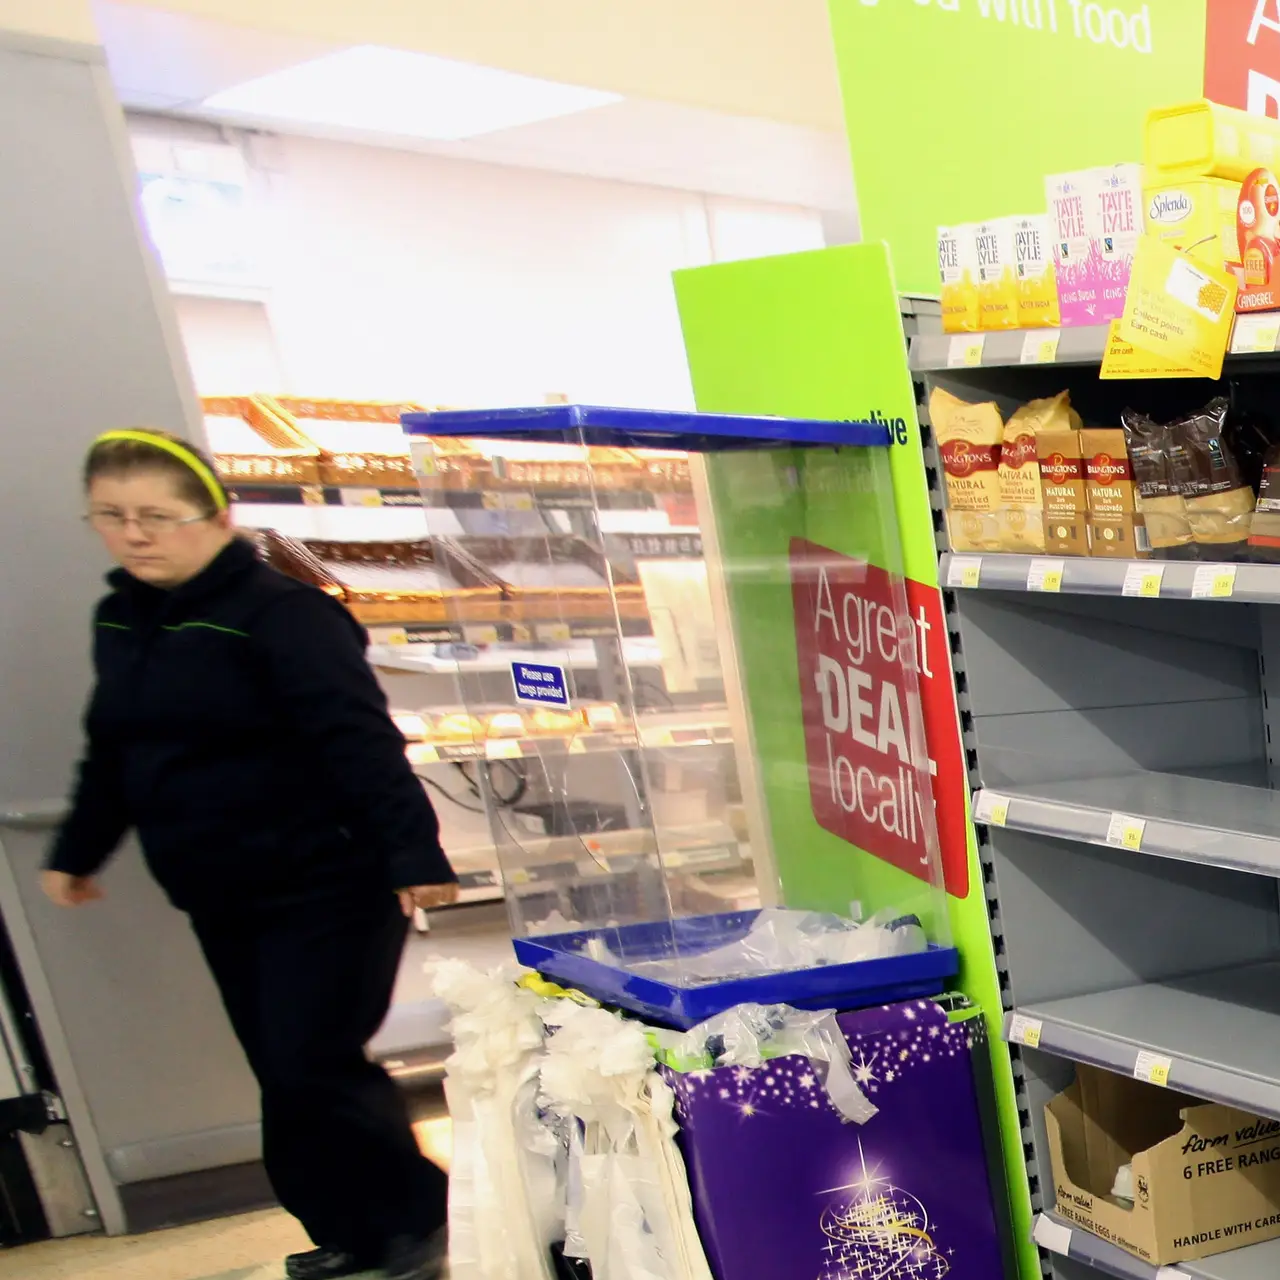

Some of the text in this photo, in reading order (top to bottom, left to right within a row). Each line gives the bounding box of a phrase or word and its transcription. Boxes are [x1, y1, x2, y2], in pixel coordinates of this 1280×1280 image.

[1071, 0, 1154, 54] food
[1053, 196, 1083, 218] TATE
[1099, 190, 1133, 213] TATE
[1150, 193, 1189, 221] Splenda
[1057, 215, 1086, 240] LYLE
[1102, 211, 1136, 234] LYLE
[1237, 291, 1275, 309] CANDEREL
[999, 470, 1035, 481] NATURAL
[1046, 487, 1076, 498] NATURAL
[1092, 488, 1123, 499] NATURAL
[813, 566, 935, 679] A great
[521, 667, 554, 683] Please use
[537, 684, 563, 698] provided
[816, 651, 938, 775] DEAL
[826, 733, 938, 864] locally
[1181, 1132, 1230, 1156] farm
[1183, 1164, 1193, 1181] 6
[1197, 1157, 1235, 1178] FREE
[1061, 1204, 1075, 1221] FREE
[1075, 1211, 1095, 1231] RANGE
[1173, 1228, 1222, 1248] HANDLE
[1223, 1220, 1253, 1238] WITH
